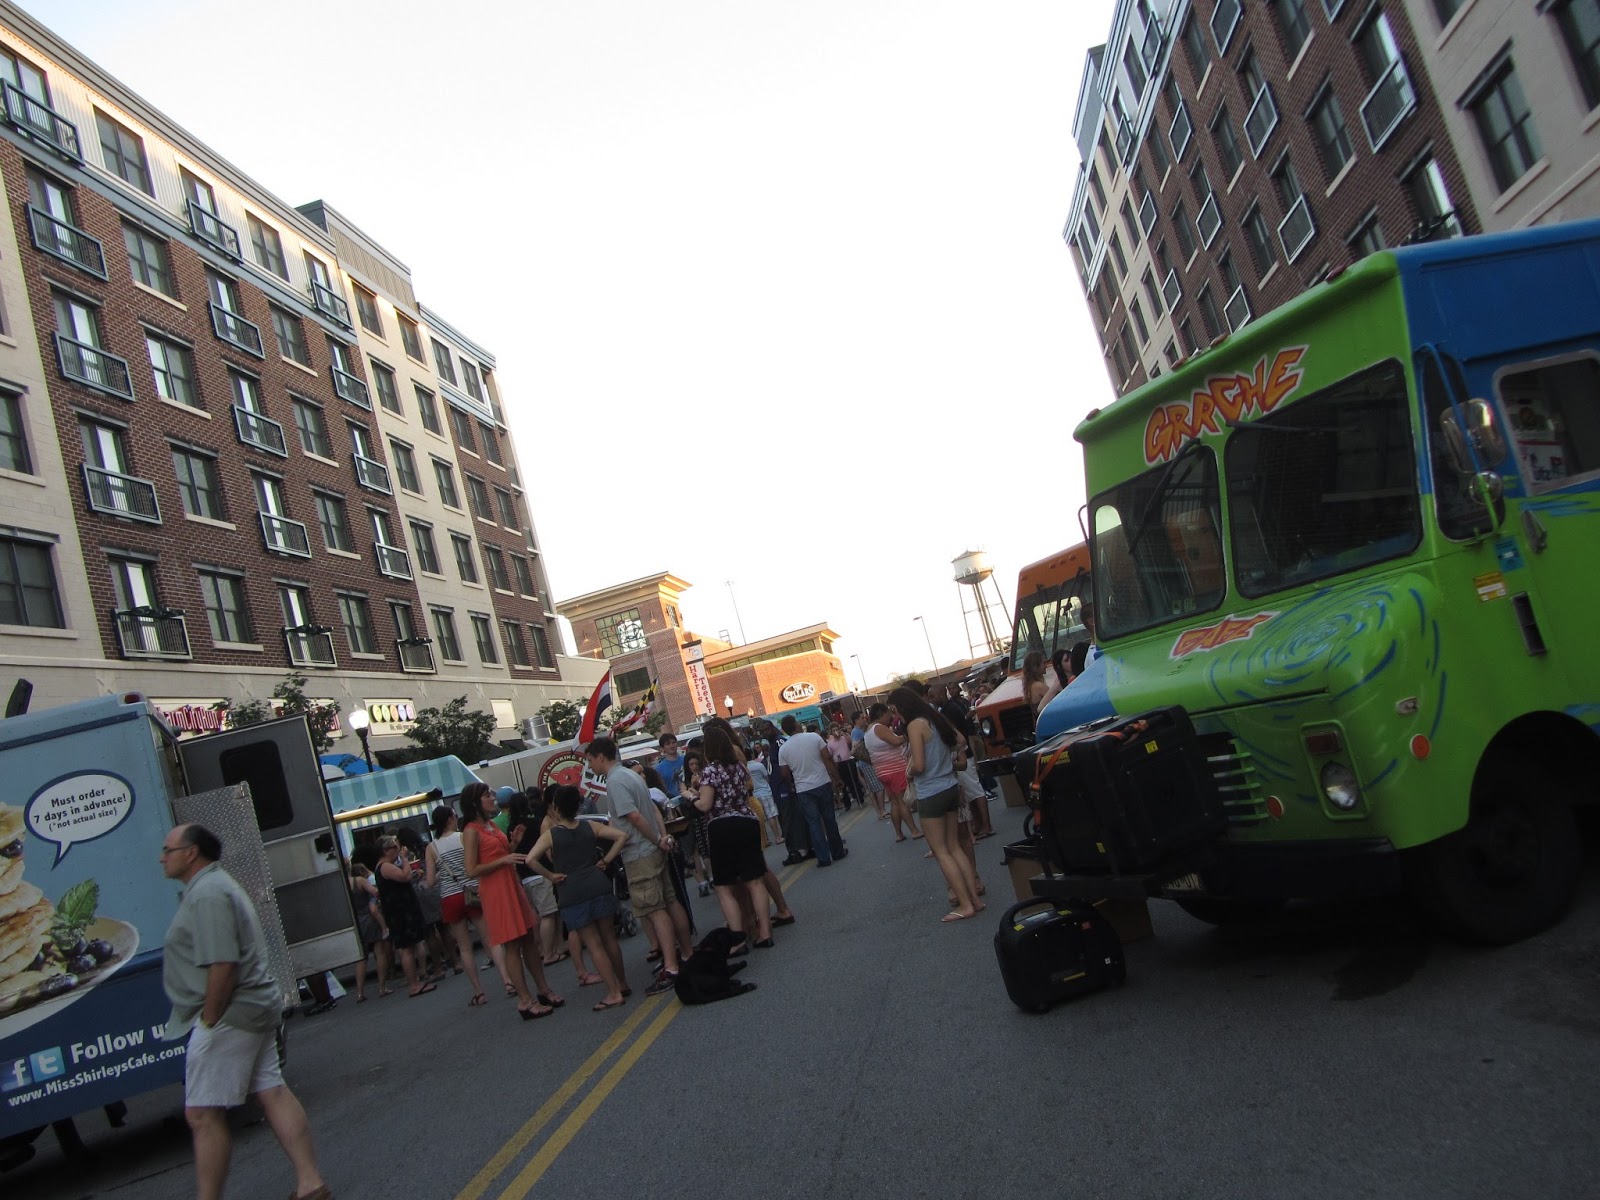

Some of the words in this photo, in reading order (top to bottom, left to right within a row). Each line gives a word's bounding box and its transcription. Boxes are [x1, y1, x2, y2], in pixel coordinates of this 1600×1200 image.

[689, 665, 702, 702] Harris
[699, 678, 713, 713] Teeter
[547, 754, 576, 770] SMOKING
[33, 814, 40, 824] 7
[44, 809, 68, 822] days
[70, 806, 81, 815] in
[83, 793, 127, 812] advance!
[51, 795, 76, 808] Must
[78, 788, 106, 801] order
[72, 812, 96, 825] actual
[97, 806, 118, 819] size)
[70, 1029, 144, 1064] Follow
[8, 1045, 186, 1107] www.MissShirleysCafe.com
